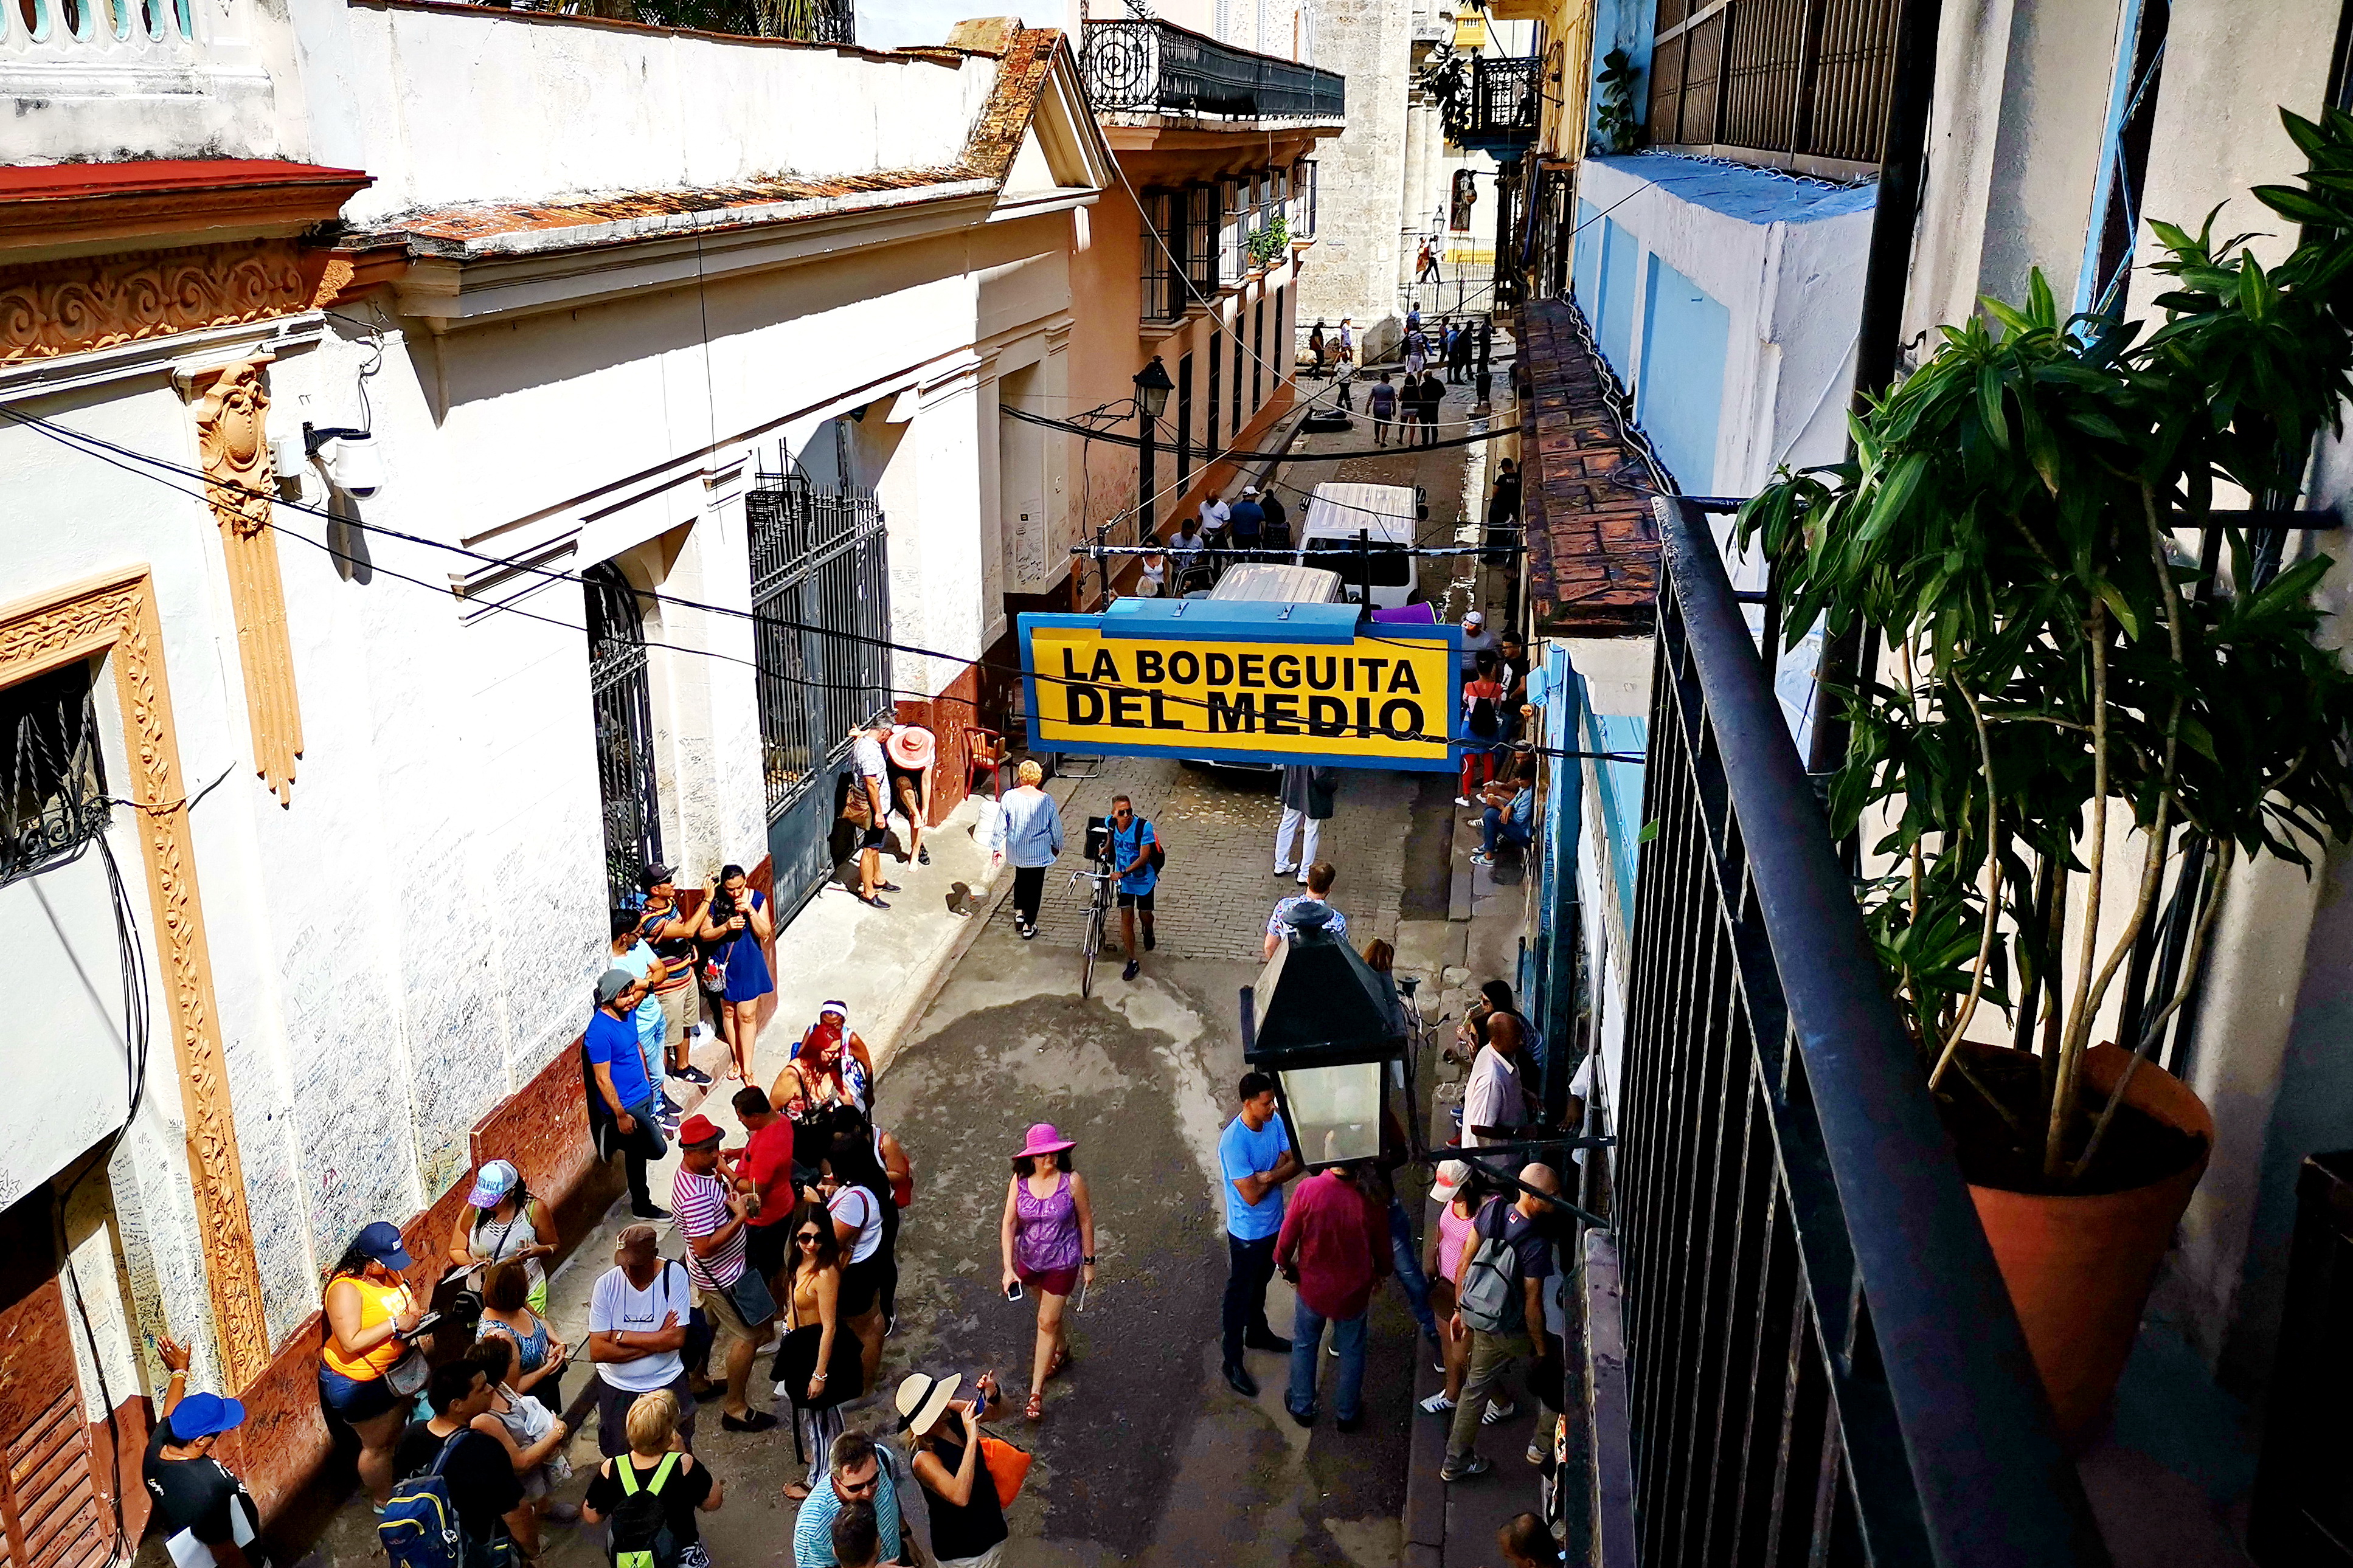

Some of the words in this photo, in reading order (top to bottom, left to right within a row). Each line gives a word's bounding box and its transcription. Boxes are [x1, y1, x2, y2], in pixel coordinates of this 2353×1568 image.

[1062, 648, 1121, 682] LA
[1136, 650, 1421, 694] BODEGUITA
[1066, 685, 1183, 729] DEL
[1208, 691, 1424, 741] MEDIO
